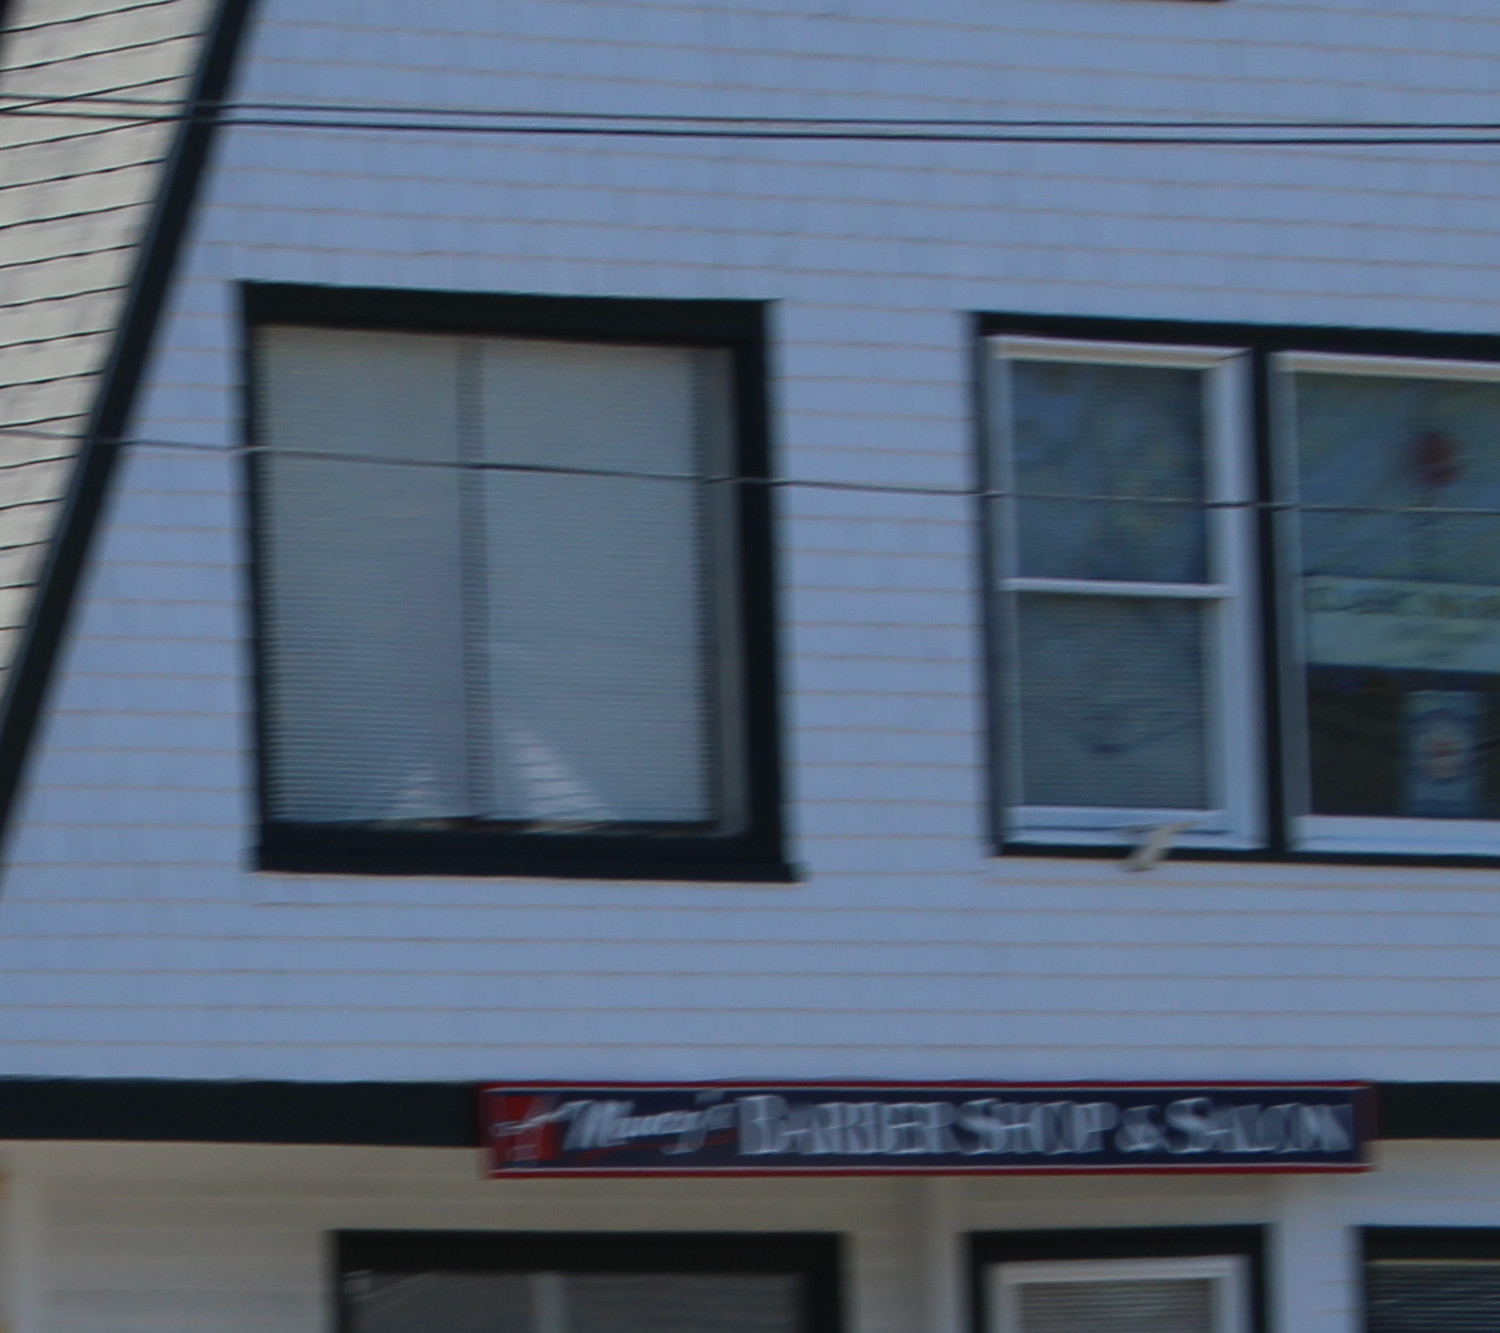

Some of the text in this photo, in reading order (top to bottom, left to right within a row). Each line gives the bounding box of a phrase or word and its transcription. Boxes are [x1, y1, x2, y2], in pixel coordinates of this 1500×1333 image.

[739, 1095, 958, 1154] BARBER
[960, 1097, 1115, 1154] SHOP
[1114, 1105, 1162, 1153] &
[1165, 1097, 1353, 1154] SALON
